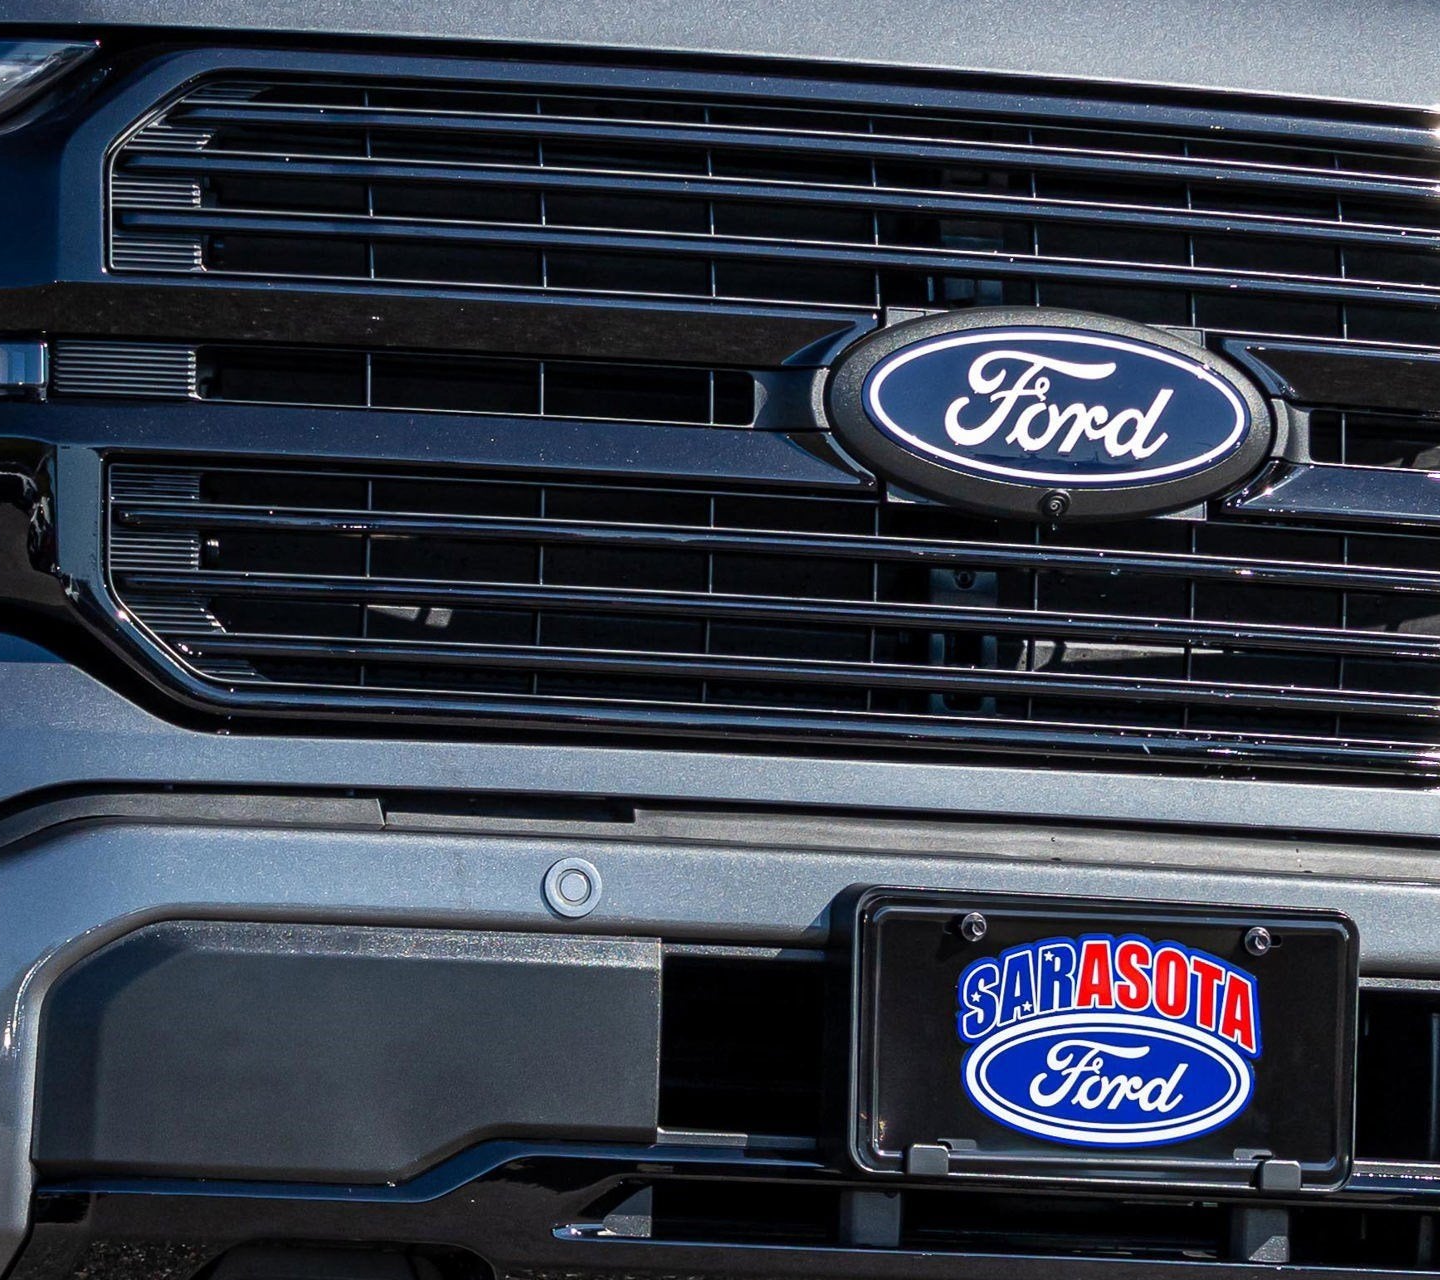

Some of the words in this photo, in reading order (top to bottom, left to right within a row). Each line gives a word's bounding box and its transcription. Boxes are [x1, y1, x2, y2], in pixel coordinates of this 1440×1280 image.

[944, 350, 1173, 459] Ford
[962, 939, 1258, 1054] SARASOTA
[1029, 1039, 1189, 1113] Ford
